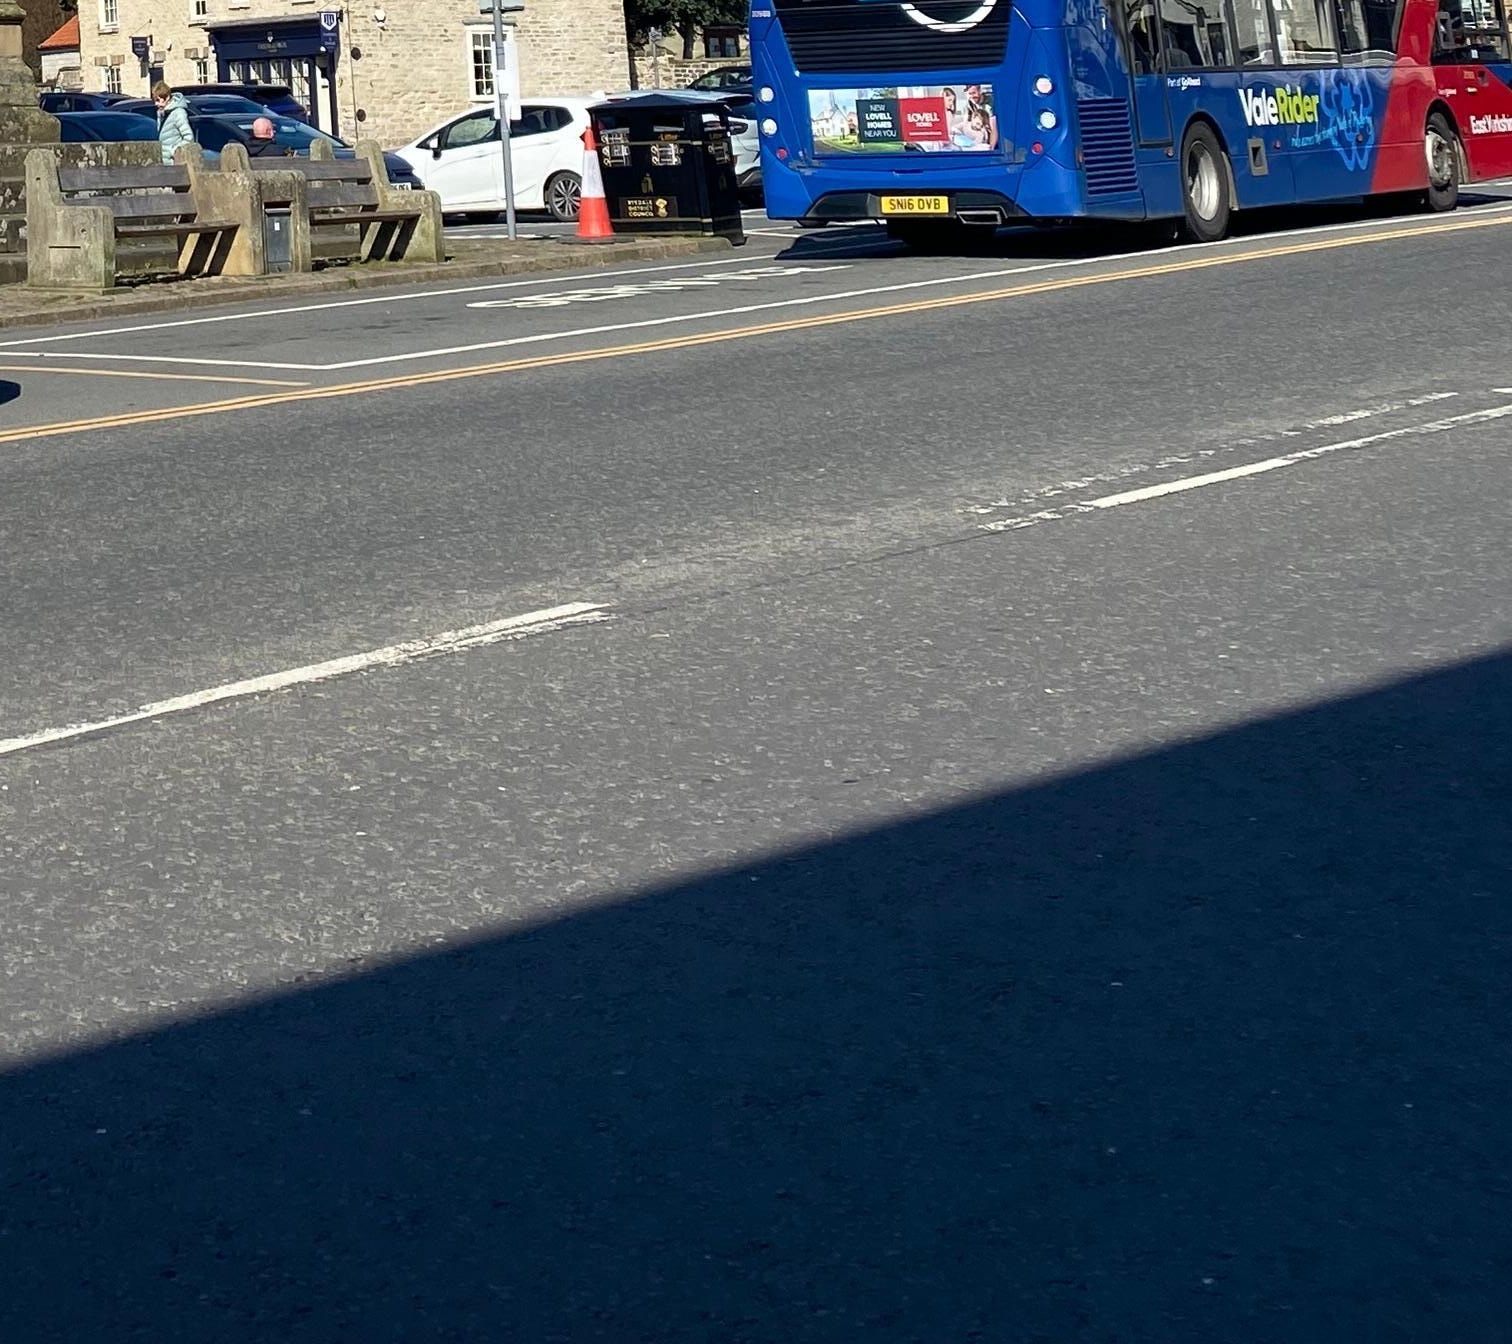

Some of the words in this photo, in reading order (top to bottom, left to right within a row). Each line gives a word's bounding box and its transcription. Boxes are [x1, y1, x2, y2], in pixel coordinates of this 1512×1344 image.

[1238, 84, 1320, 126] ValeRider
[889, 199, 915, 210] SN16
[918, 199, 941, 210] OVB
